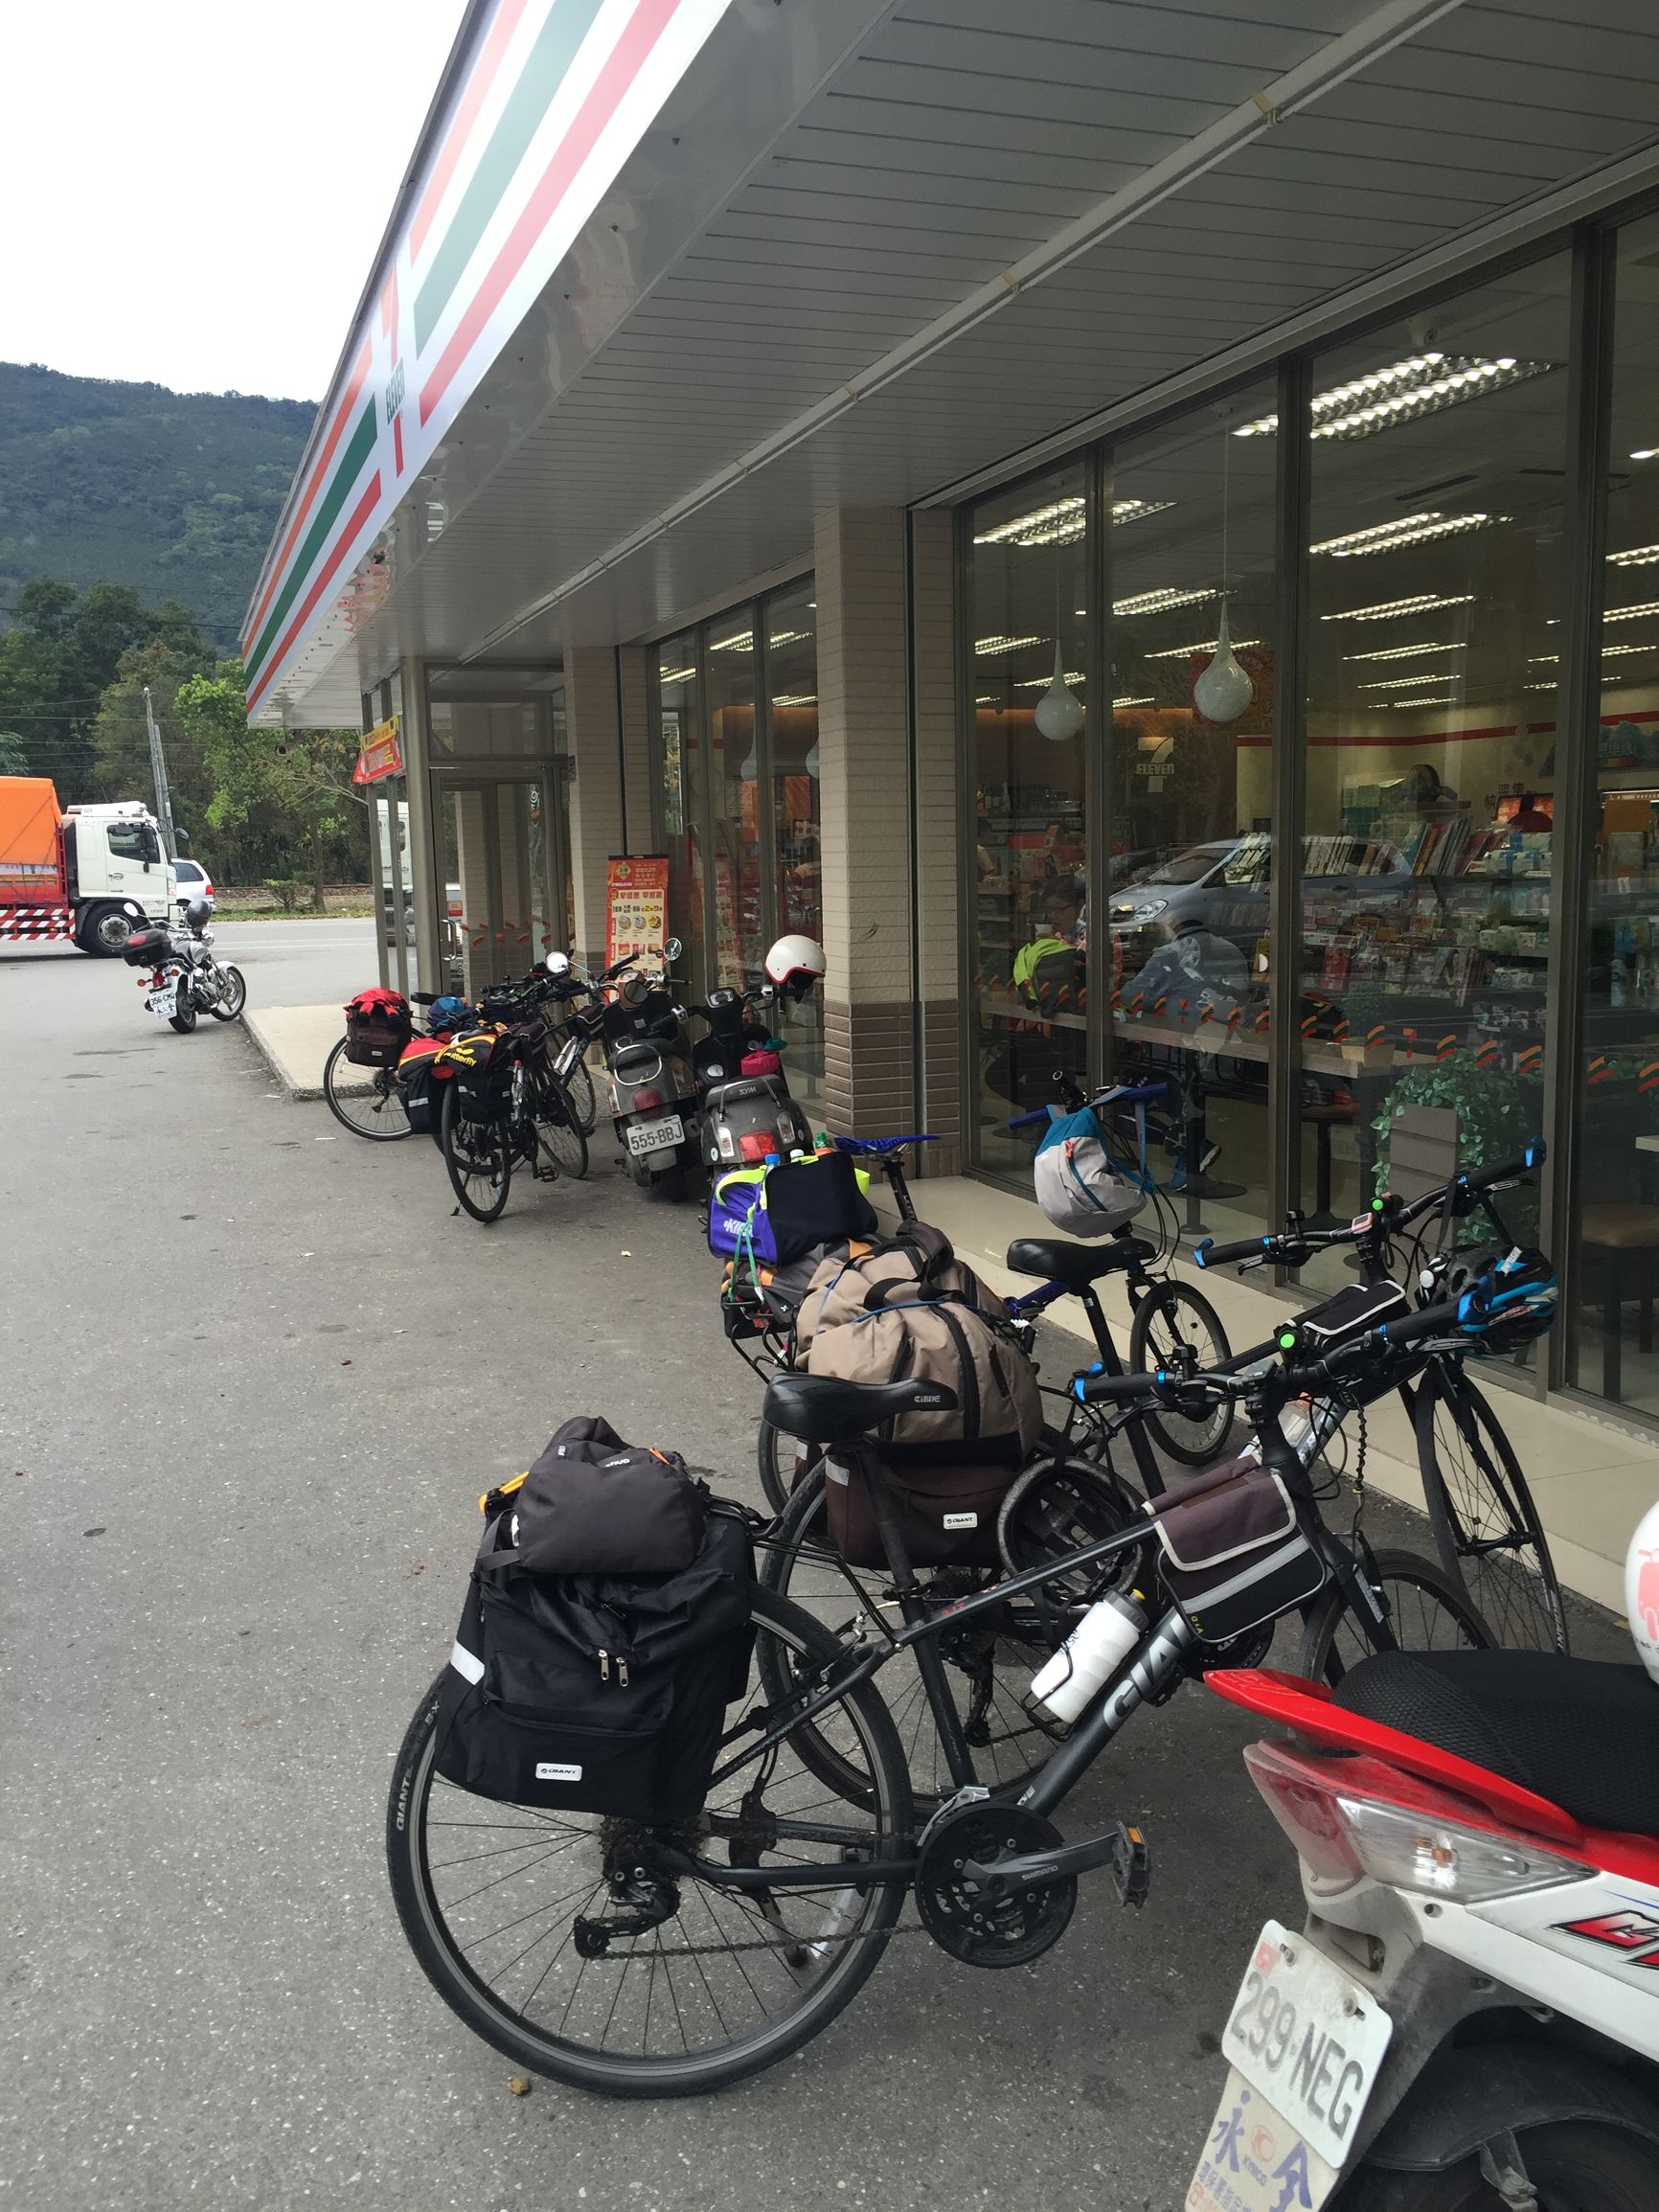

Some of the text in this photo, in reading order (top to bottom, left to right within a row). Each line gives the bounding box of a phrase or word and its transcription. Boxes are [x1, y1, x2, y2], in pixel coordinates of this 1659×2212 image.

[1137, 736, 1174, 793] 7
[739, 1085, 757, 1096] SYM
[396, 1777, 410, 1831] GIANT
[1021, 1864, 1058, 1881] SHIMANO
